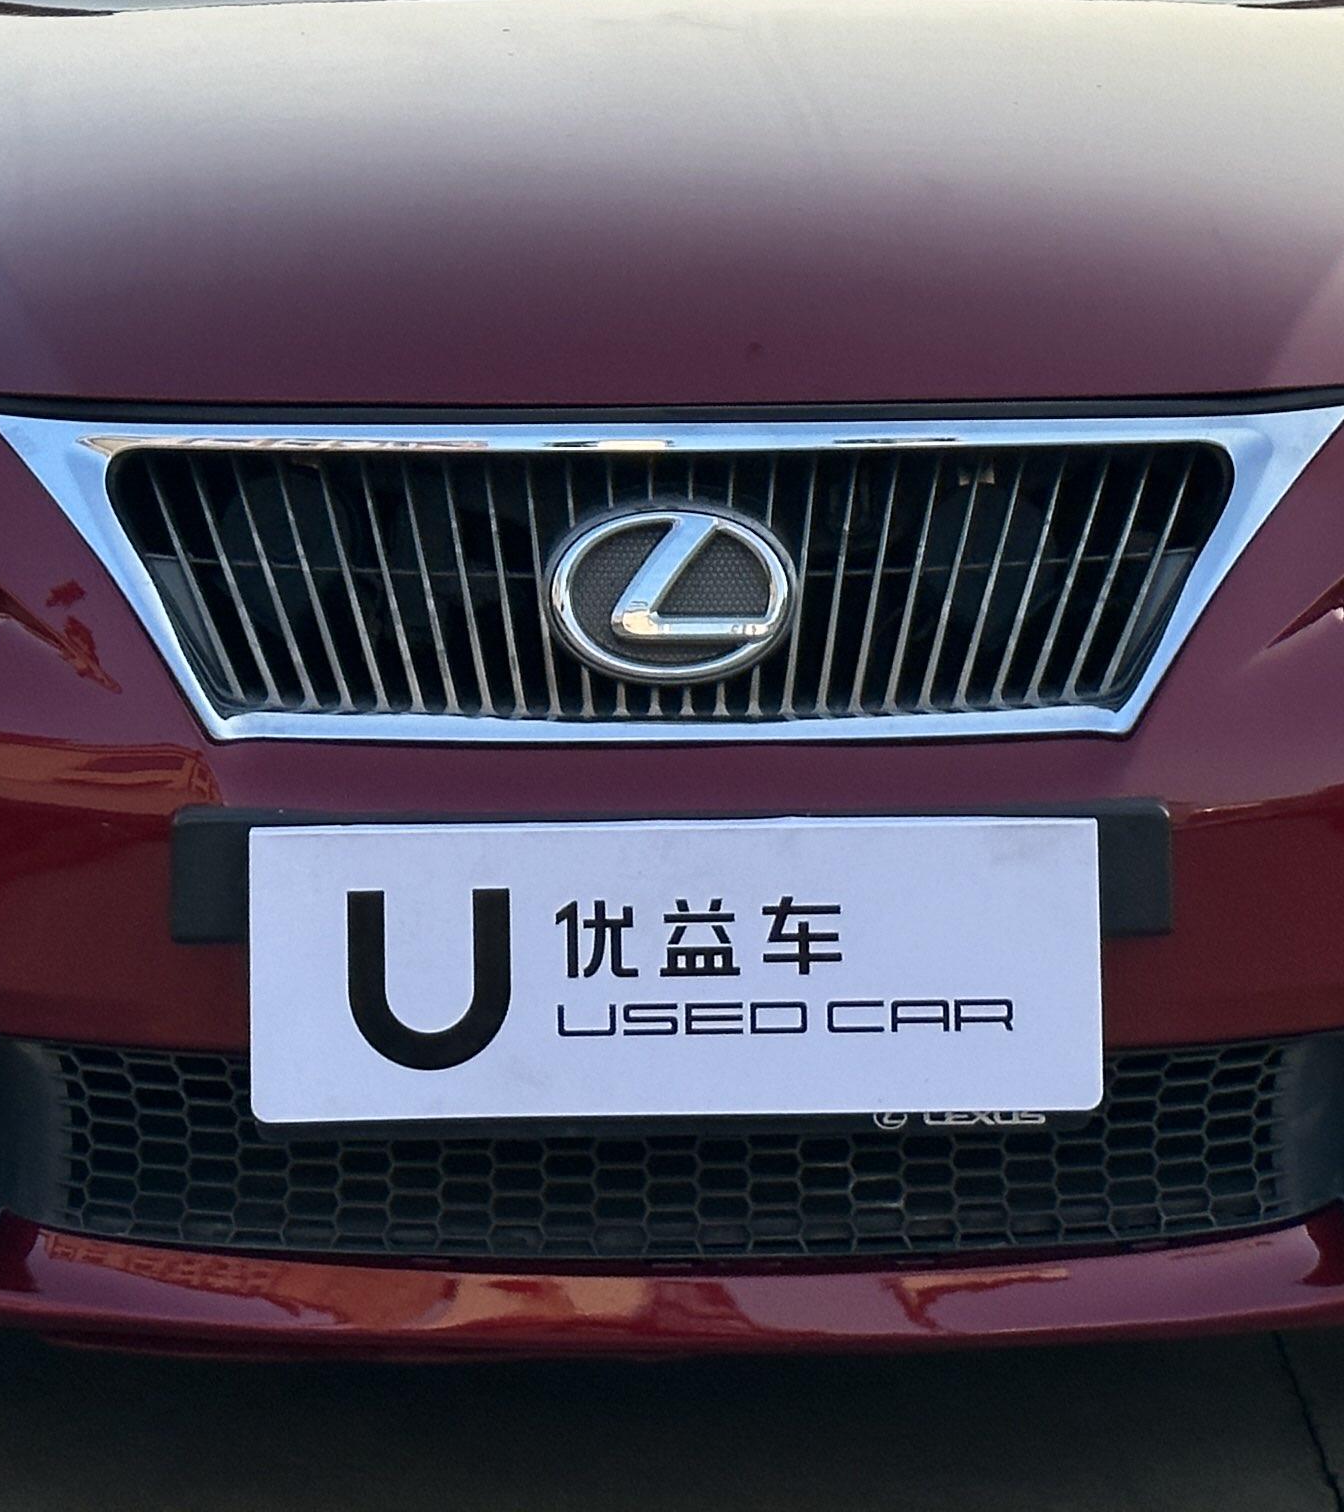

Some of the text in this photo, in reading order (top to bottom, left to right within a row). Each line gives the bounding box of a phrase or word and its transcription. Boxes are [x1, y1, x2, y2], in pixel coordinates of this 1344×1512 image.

[554, 895, 843, 979] 优益车
[557, 998, 1014, 1037] USED CAR
